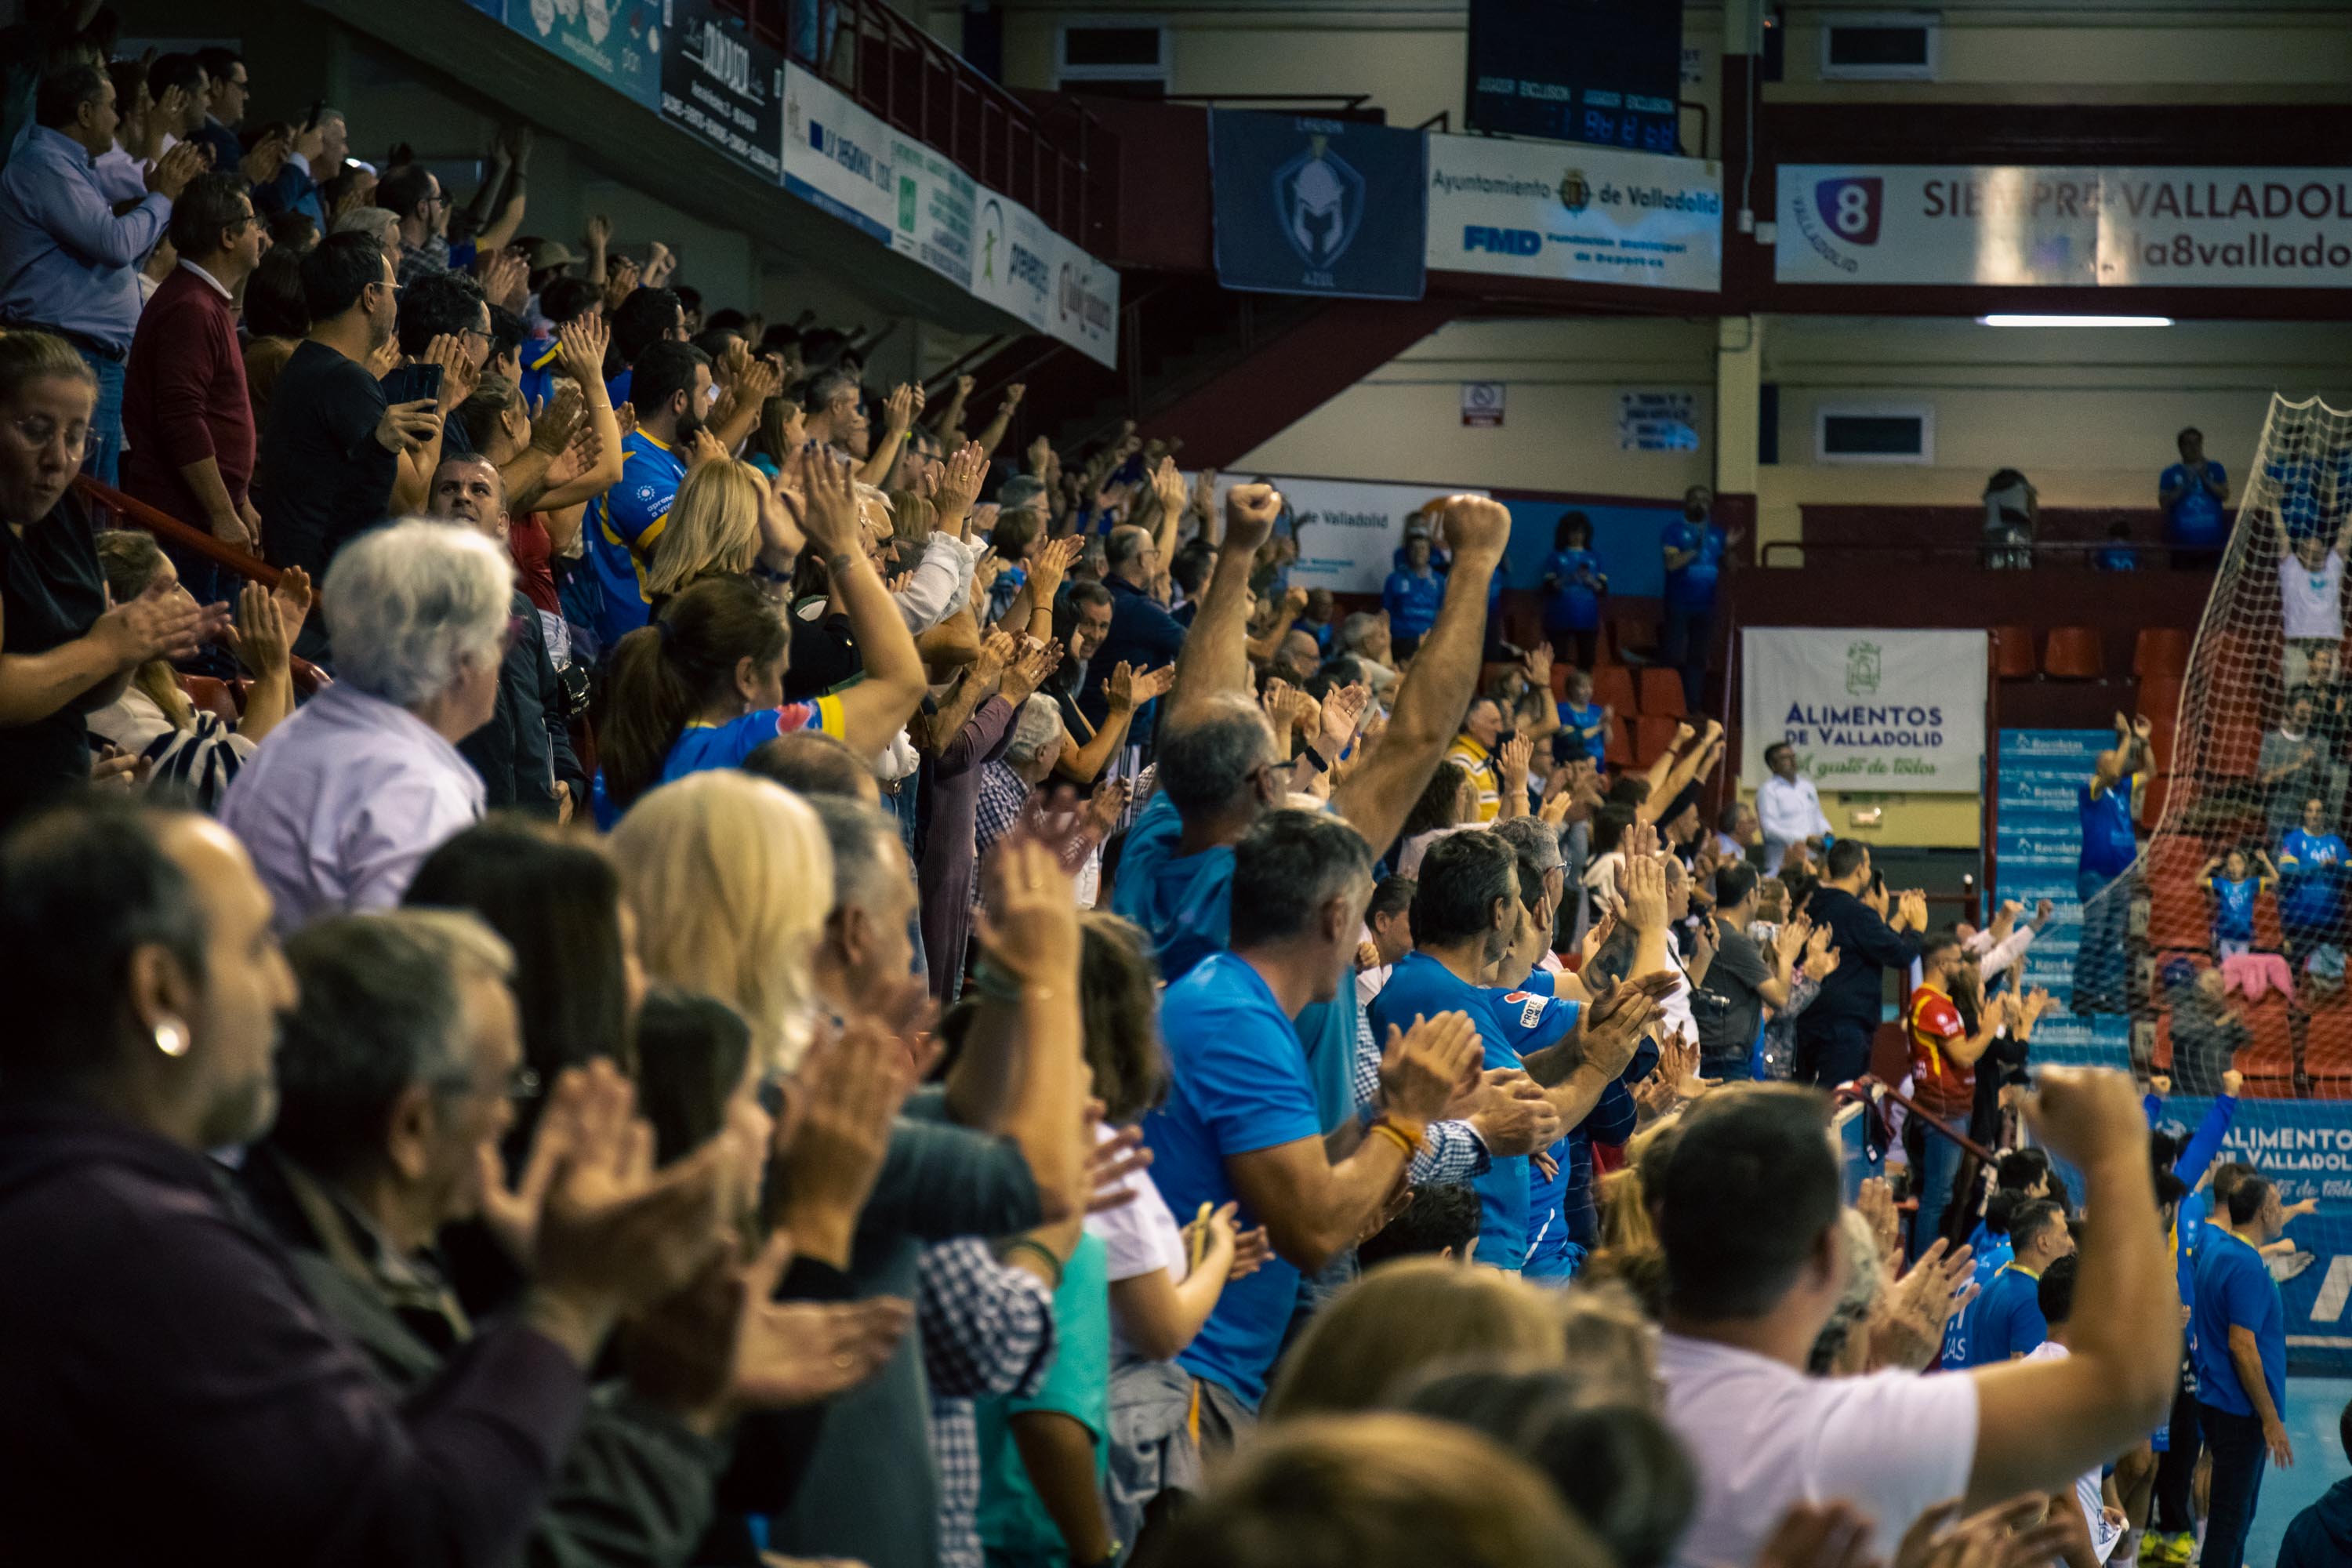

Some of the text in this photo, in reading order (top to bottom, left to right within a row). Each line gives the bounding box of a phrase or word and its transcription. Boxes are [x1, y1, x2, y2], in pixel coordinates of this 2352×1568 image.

[1432, 169, 1719, 215] Ayuntamiento de Valladolid
[1836, 183, 1869, 234] 8
[1464, 225, 1541, 256] FMD
[2089, 231, 2352, 269] la8vallado
[1322, 510, 1388, 528] Valladolid
[1785, 700, 1943, 726] ALIMENTOS
[1785, 726, 1944, 746] DE VALLADOLID
[2222, 1127, 2352, 1151] ALIMENTO
